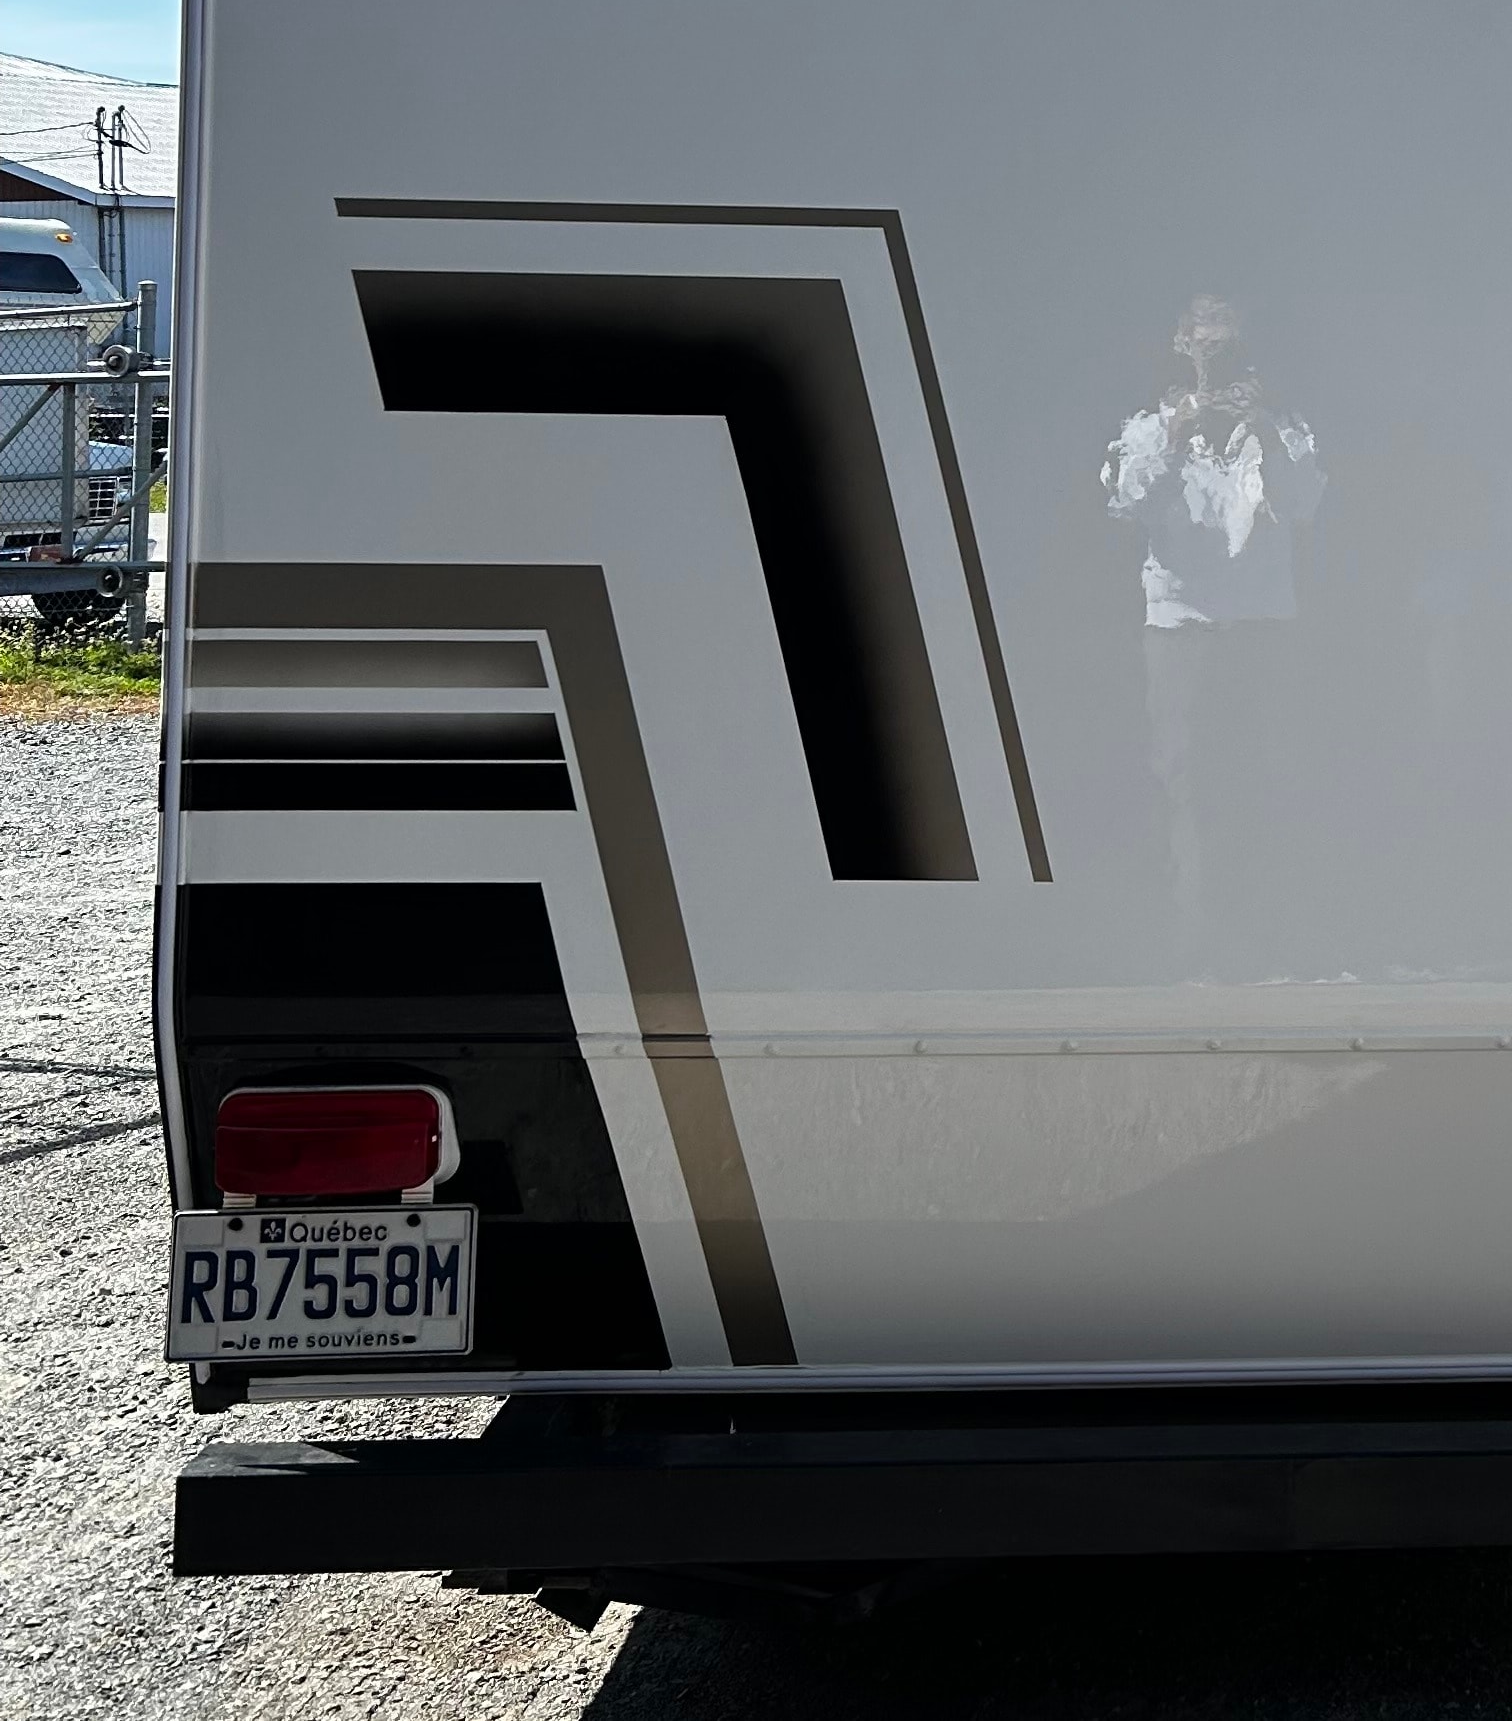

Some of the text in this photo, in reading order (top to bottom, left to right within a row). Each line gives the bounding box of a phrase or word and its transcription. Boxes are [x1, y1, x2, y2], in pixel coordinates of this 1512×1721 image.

[290, 1219, 388, 1243] Québec
[180, 1244, 460, 1324] RB7558M
[235, 1329, 401, 1351] Je me souviens
